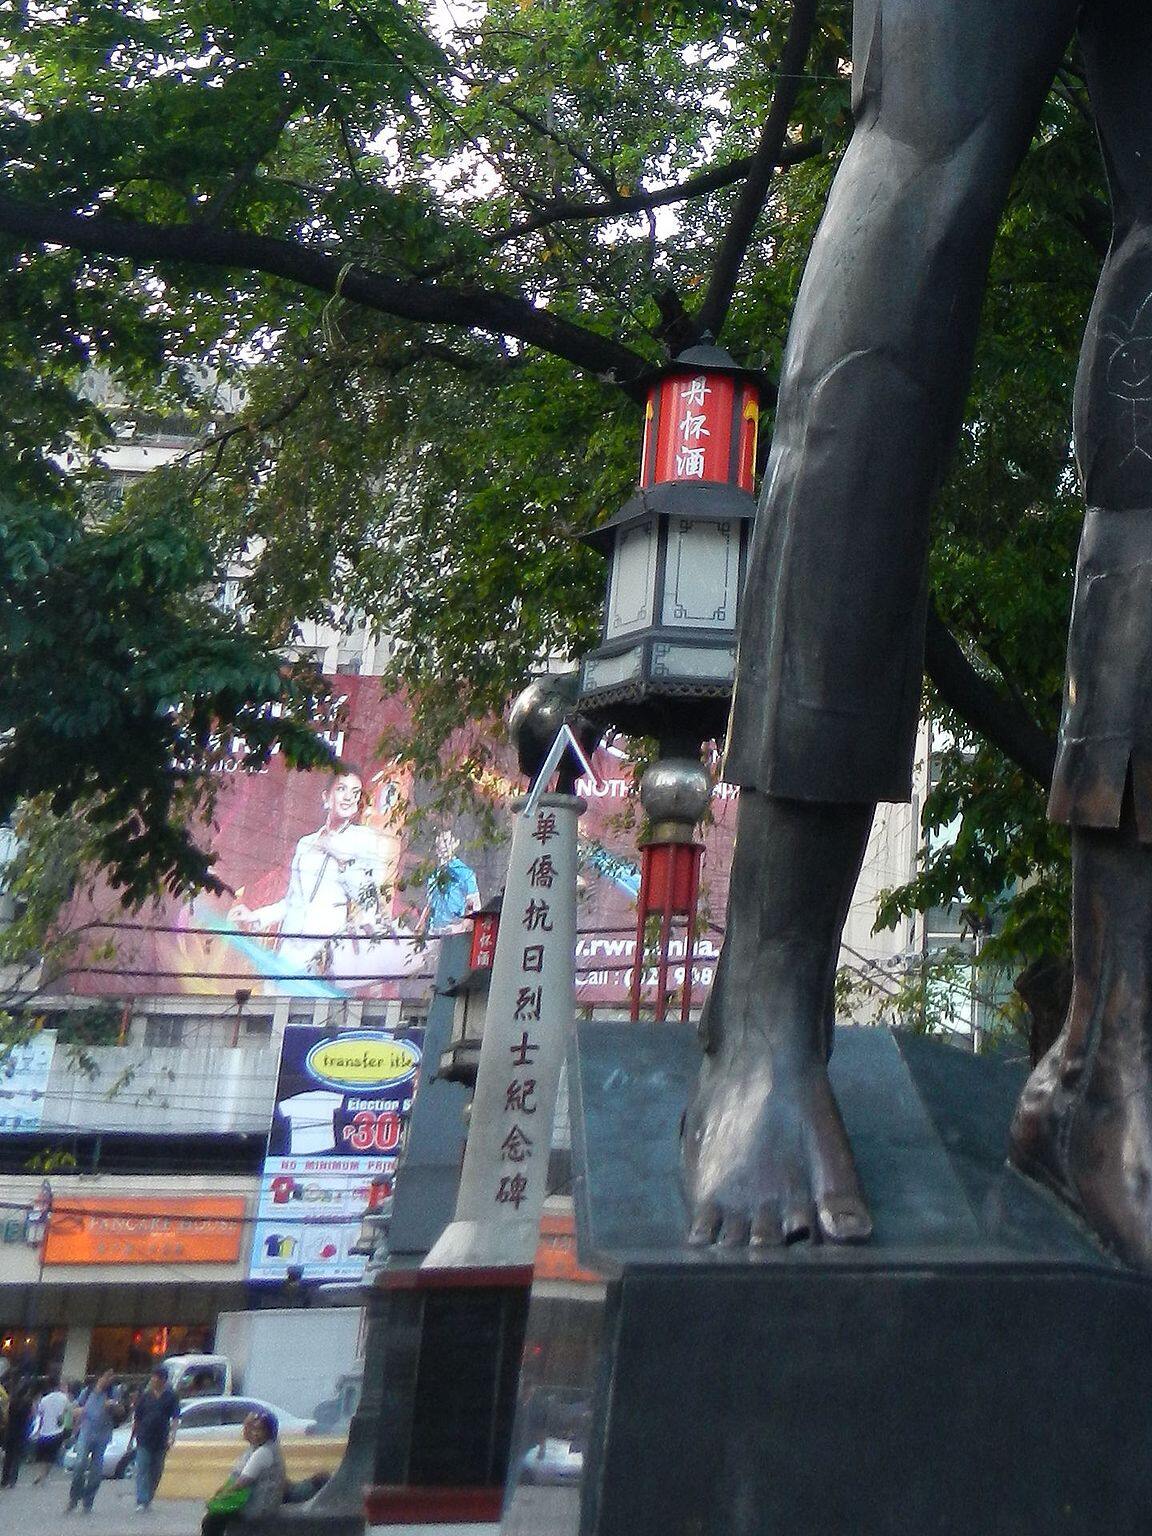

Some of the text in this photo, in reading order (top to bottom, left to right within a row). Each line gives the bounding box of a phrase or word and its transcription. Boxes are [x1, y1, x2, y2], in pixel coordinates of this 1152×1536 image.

[495, 810, 560, 1211] 華僑抗日烈士紀念碑
[323, 1051, 384, 1068] transfer
[347, 1098, 399, 1111] Election
[281, 1161, 297, 1170] NO
[305, 1161, 359, 1171] MINIMUM
